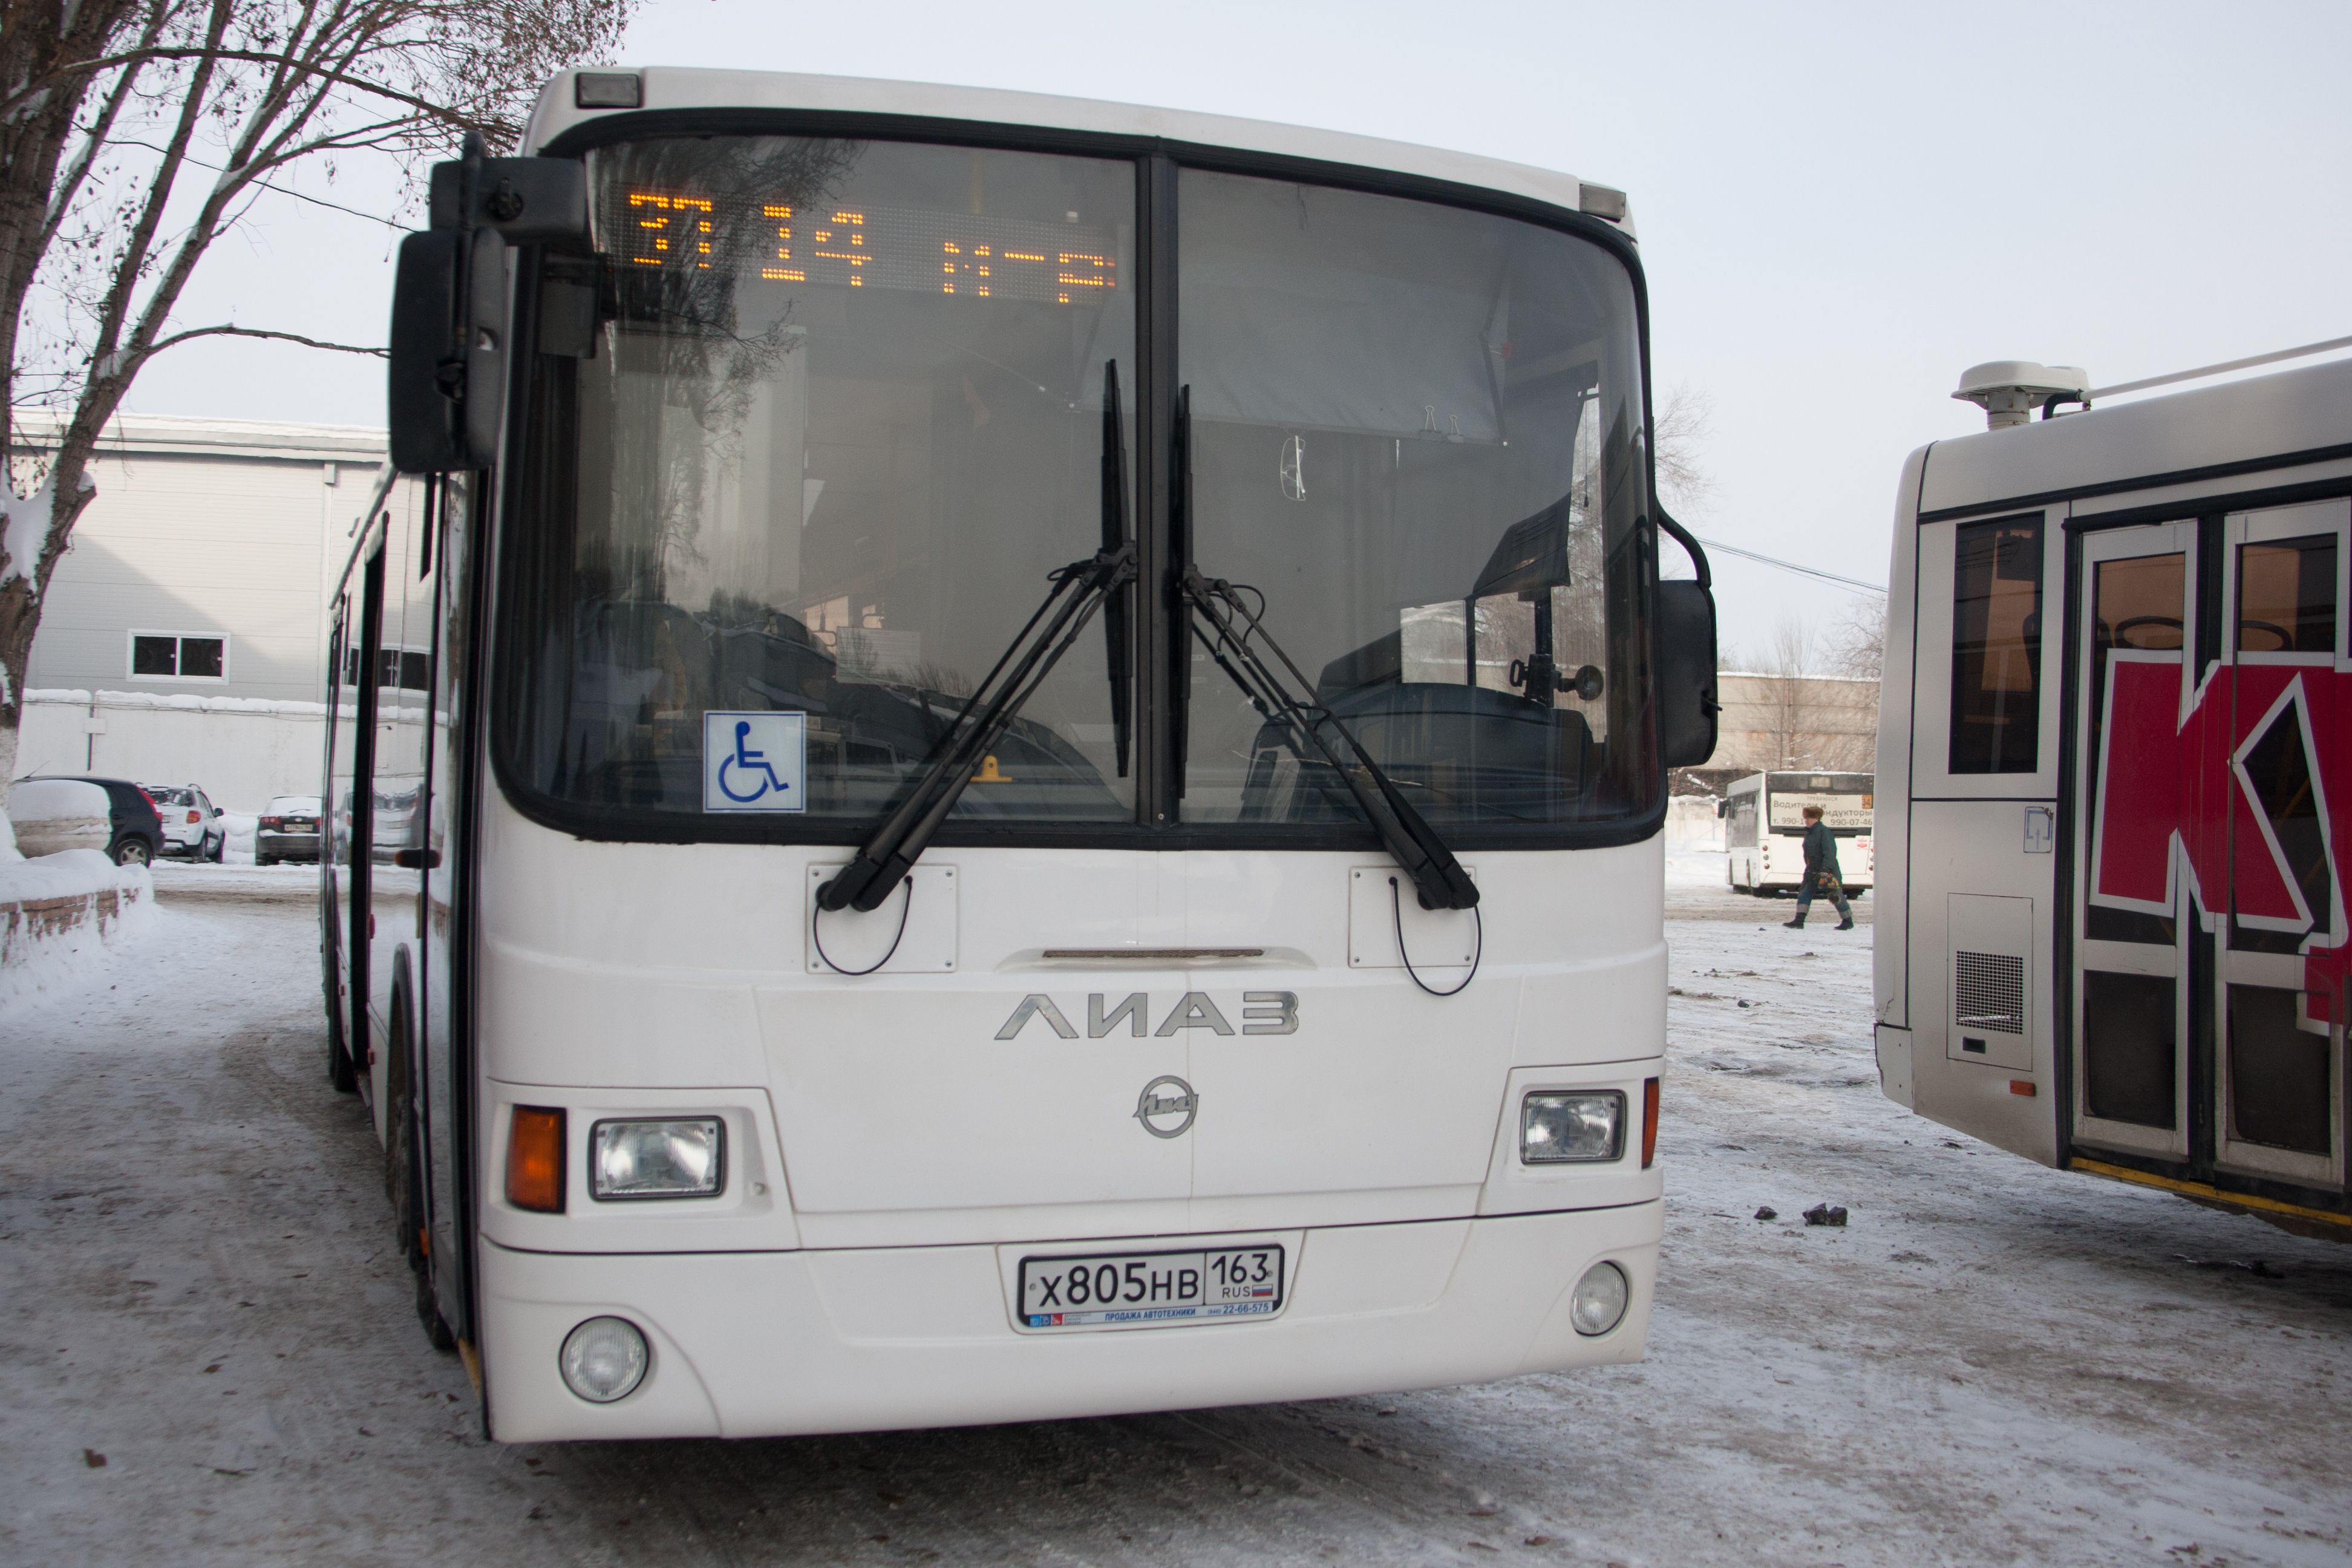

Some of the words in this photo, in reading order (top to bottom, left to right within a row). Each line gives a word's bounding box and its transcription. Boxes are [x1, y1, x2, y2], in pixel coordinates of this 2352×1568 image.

[630, 194, 712, 269] 37
[993, 991, 1299, 1040] ЛИАЗ
[1212, 1253, 1269, 1285] 163
[1222, 1285, 1251, 1299] RUS
[1105, 1313, 1141, 1322] ПРОДАЖА
[1143, 1308, 1195, 1319] АВТОТЕХНИКИ
[1223, 1302, 1269, 1315] 22-66-575
